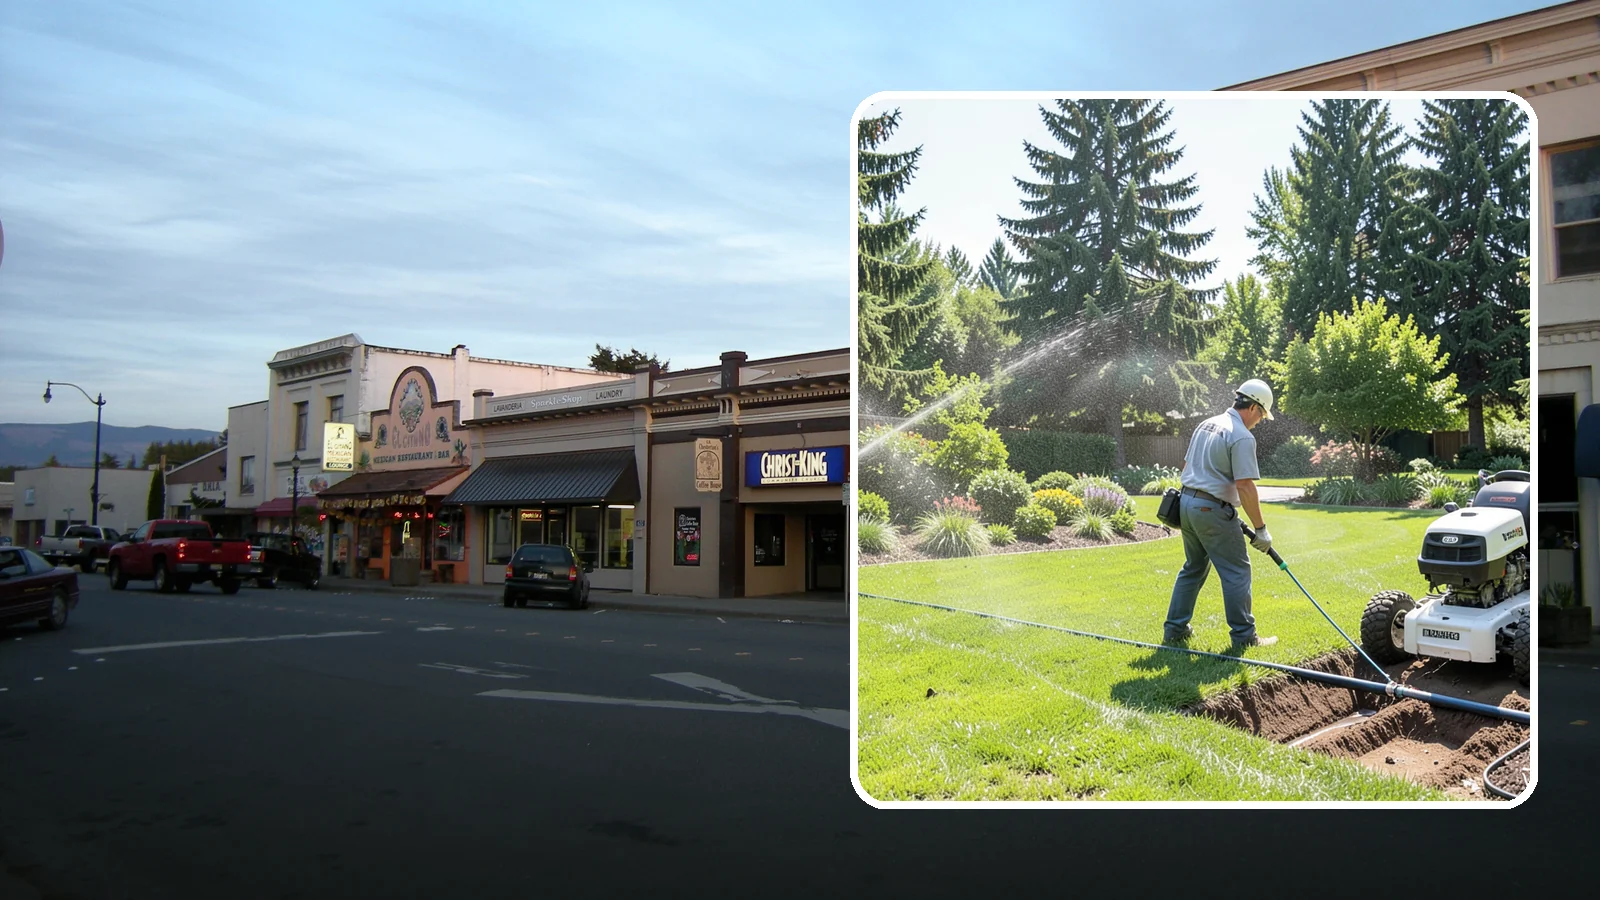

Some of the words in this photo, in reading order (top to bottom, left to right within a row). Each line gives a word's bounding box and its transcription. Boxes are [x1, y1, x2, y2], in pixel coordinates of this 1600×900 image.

[595, 389, 623, 400] LAUNDRY
[493, 402, 522, 412] LAVANDERIA
[373, 455, 396, 464] MEXICAN
[397, 451, 433, 462] RESTAURANT
[437, 450, 450, 459] BAR
[761, 452, 797, 478] CHRIST
[799, 450, 827, 477] KING
[696, 481, 709, 489] Coffee
